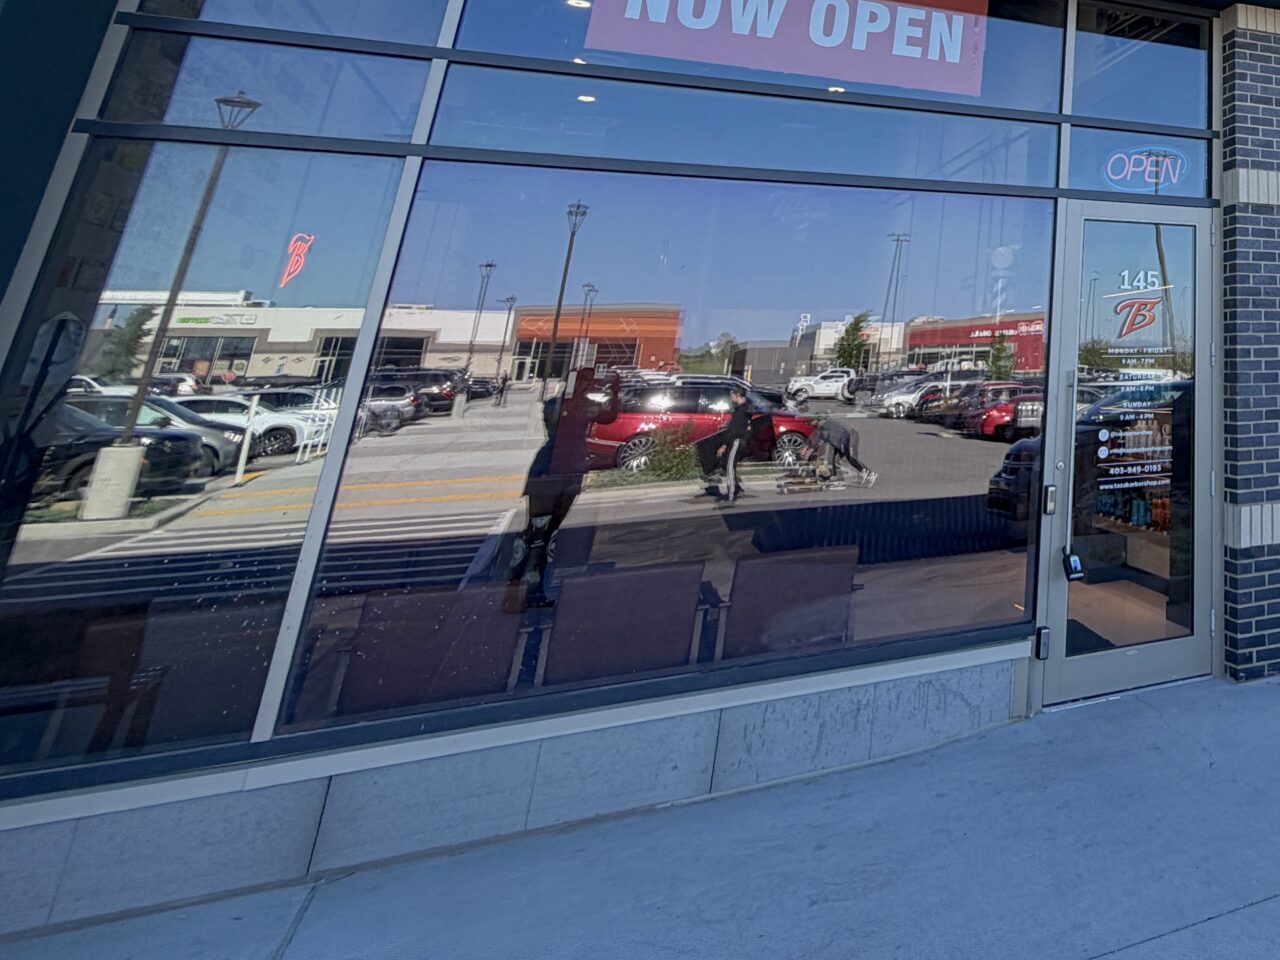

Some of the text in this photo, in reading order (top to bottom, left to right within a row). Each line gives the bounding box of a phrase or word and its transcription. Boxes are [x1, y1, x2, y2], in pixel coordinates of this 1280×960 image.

[1107, 153, 1182, 184] OPEN
[1120, 269, 1159, 290] 145
[1143, 347, 1168, 355] FRIDAY
[1123, 401, 1151, 409] SUNDAY
